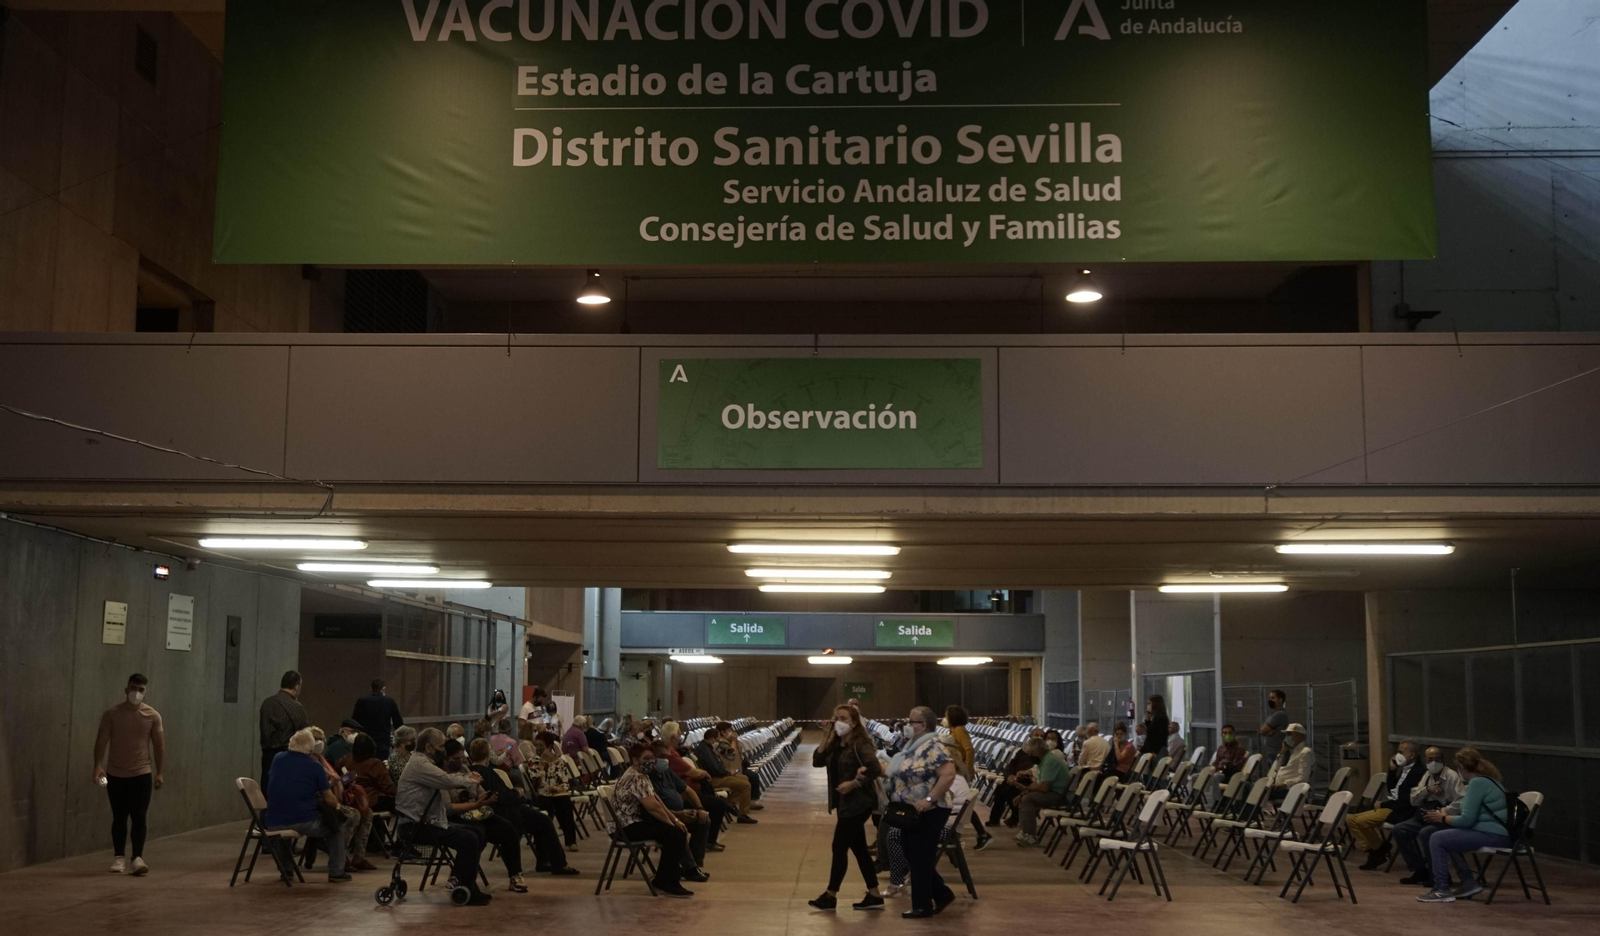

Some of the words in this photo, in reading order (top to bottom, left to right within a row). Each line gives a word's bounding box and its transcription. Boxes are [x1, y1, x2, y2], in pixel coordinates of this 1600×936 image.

[805, 0, 988, 39] COVID
[1120, 19, 1143, 34] de
[1148, 16, 1242, 34] Andalucía
[517, 65, 667, 96] Estadio
[678, 64, 727, 95] de
[740, 63, 773, 94] la
[786, 61, 937, 101] Cartuja
[512, 127, 698, 167] Distrito
[714, 125, 941, 165] Sanitario
[958, 122, 1122, 163] Sevilla
[724, 179, 845, 204] Servicio
[854, 177, 980, 202] Andaluz
[989, 177, 1026, 202] de
[1036, 176, 1121, 201] Salud
[639, 215, 805, 248] Consejería
[816, 215, 854, 240] de
[864, 214, 952, 240] Salud
[962, 221, 980, 247] y
[990, 213, 1121, 239] Familias
[722, 404, 916, 429] Observación
[730, 623, 764, 633] Salida
[898, 625, 932, 636] Salida
[852, 685, 866, 693] Salida
